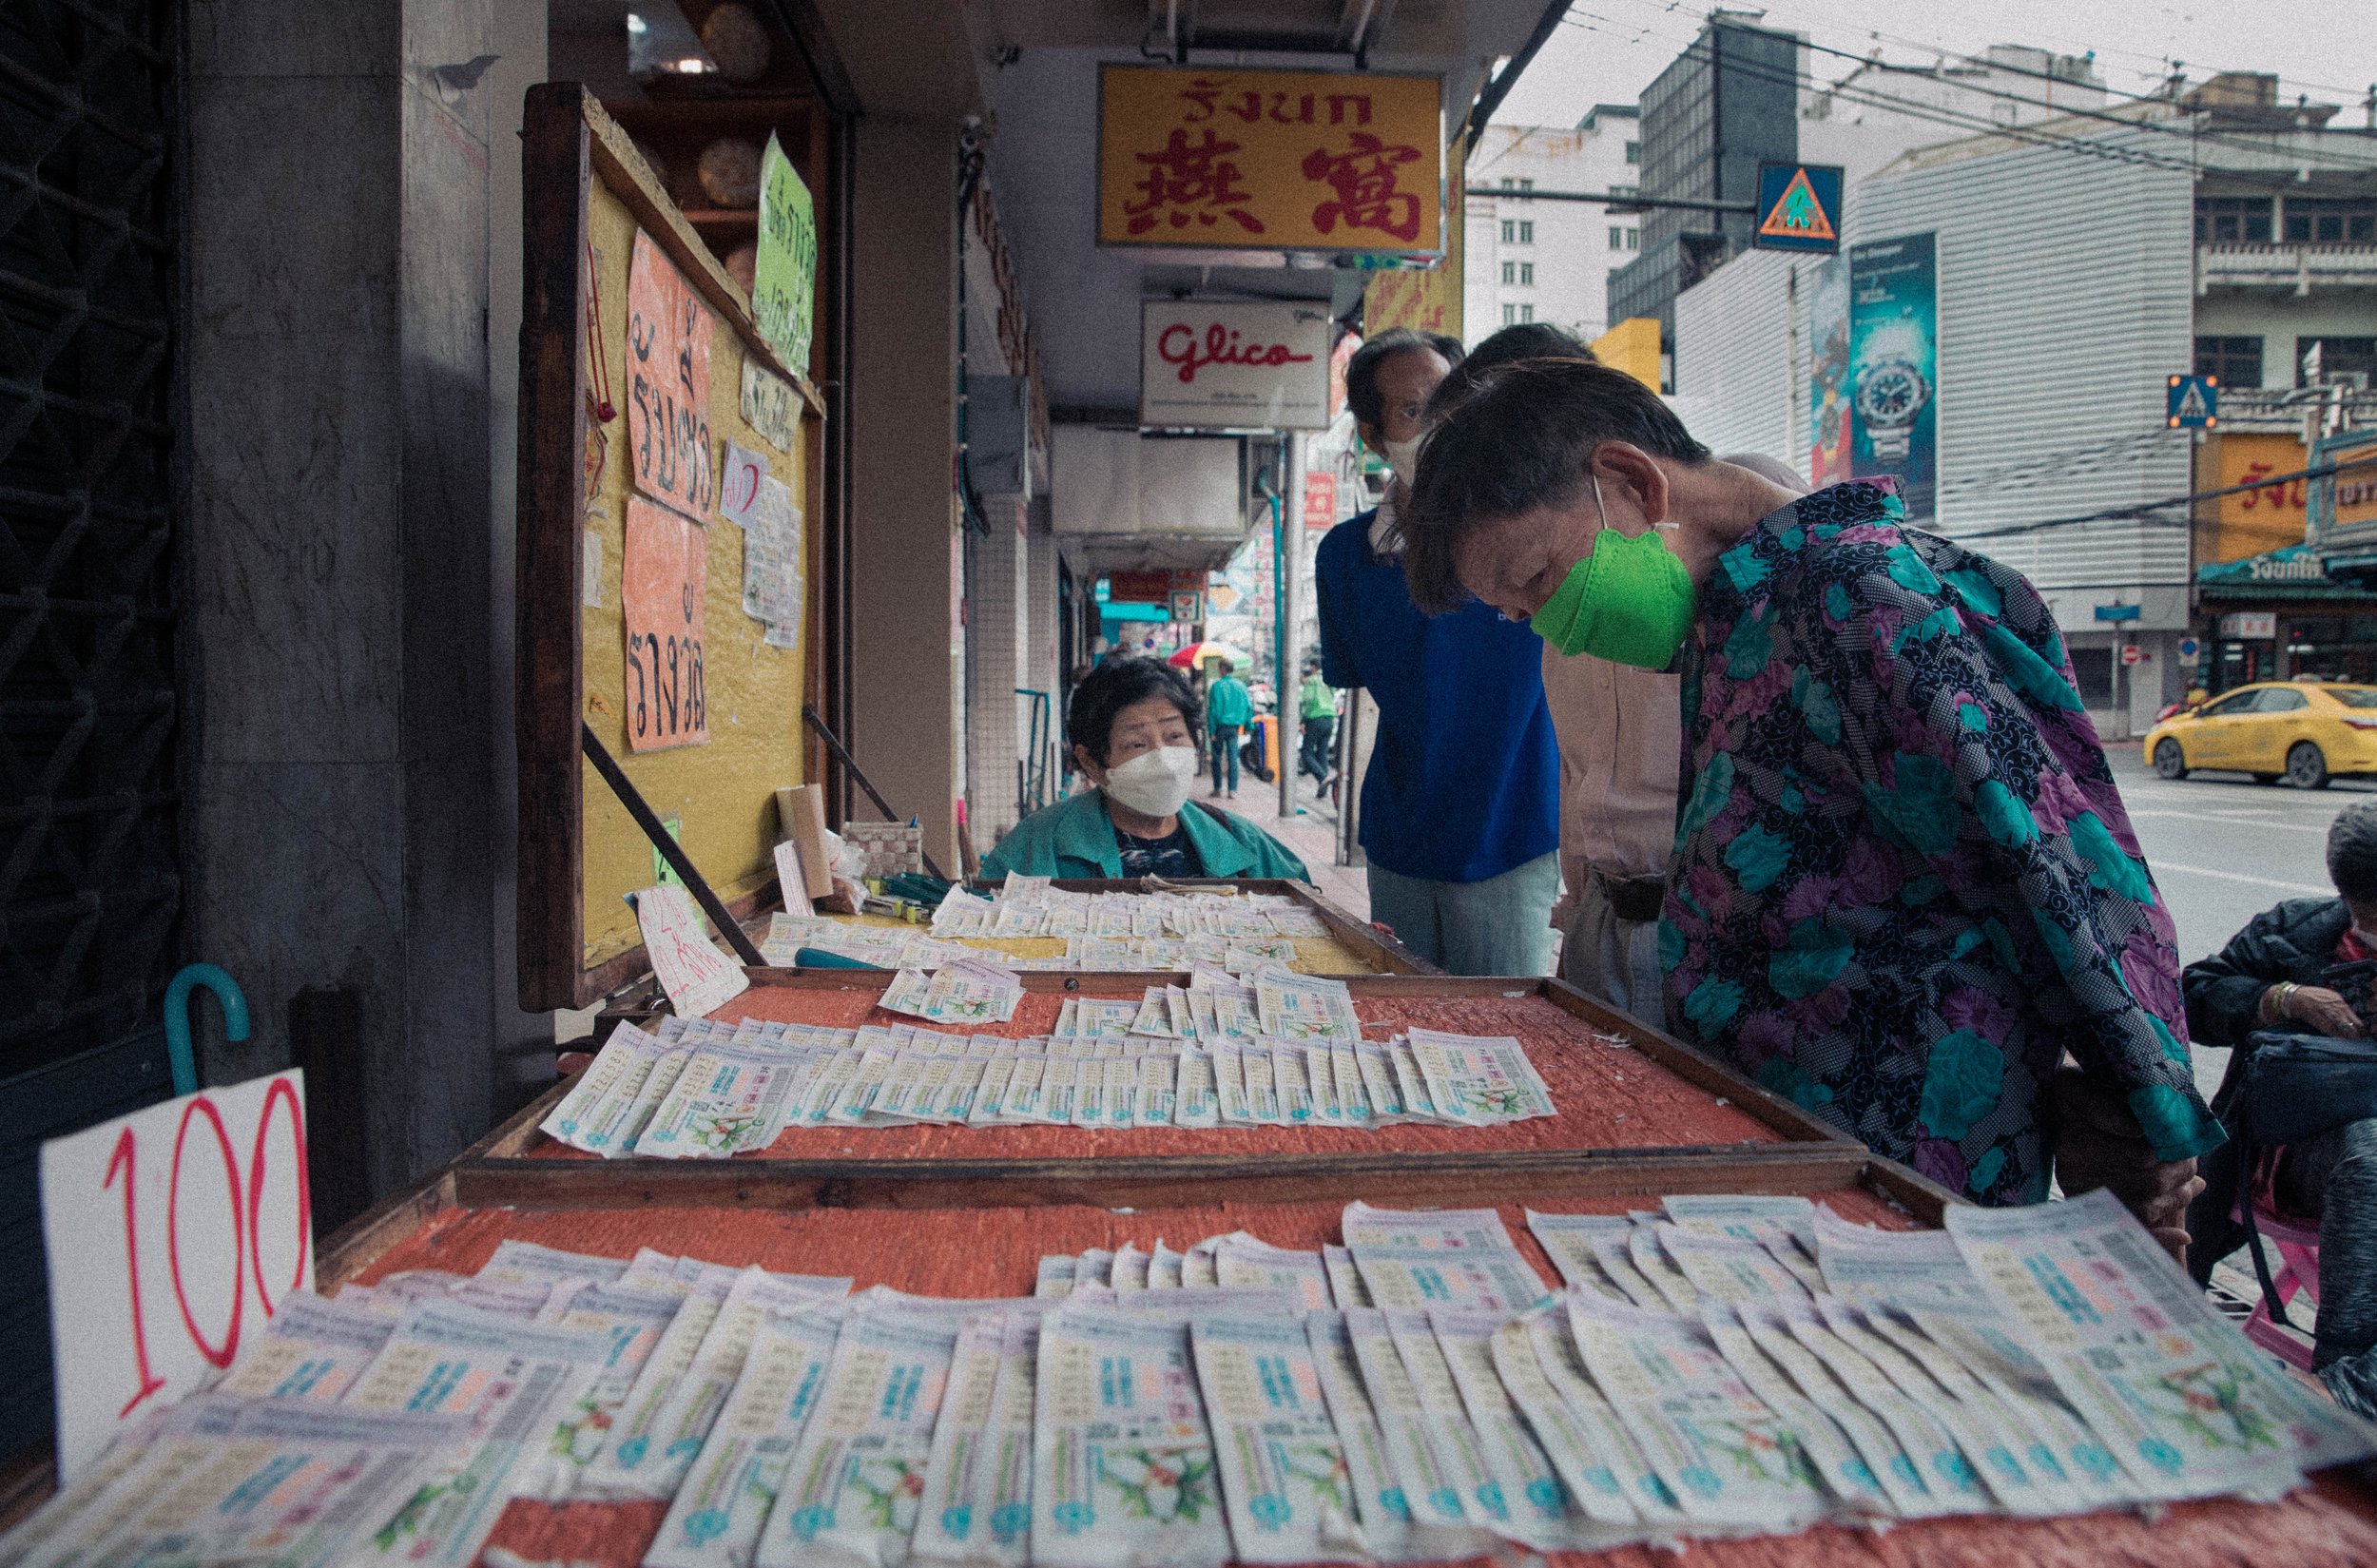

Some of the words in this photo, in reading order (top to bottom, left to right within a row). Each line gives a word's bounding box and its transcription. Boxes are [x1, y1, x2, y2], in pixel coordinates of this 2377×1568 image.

[1180, 79, 1372, 125] รังนก
[1124, 128, 1421, 242] 燕窩
[1158, 323, 1313, 383] Glico
[628, 582, 705, 738] รางวัล
[103, 1076, 311, 1422] 100
